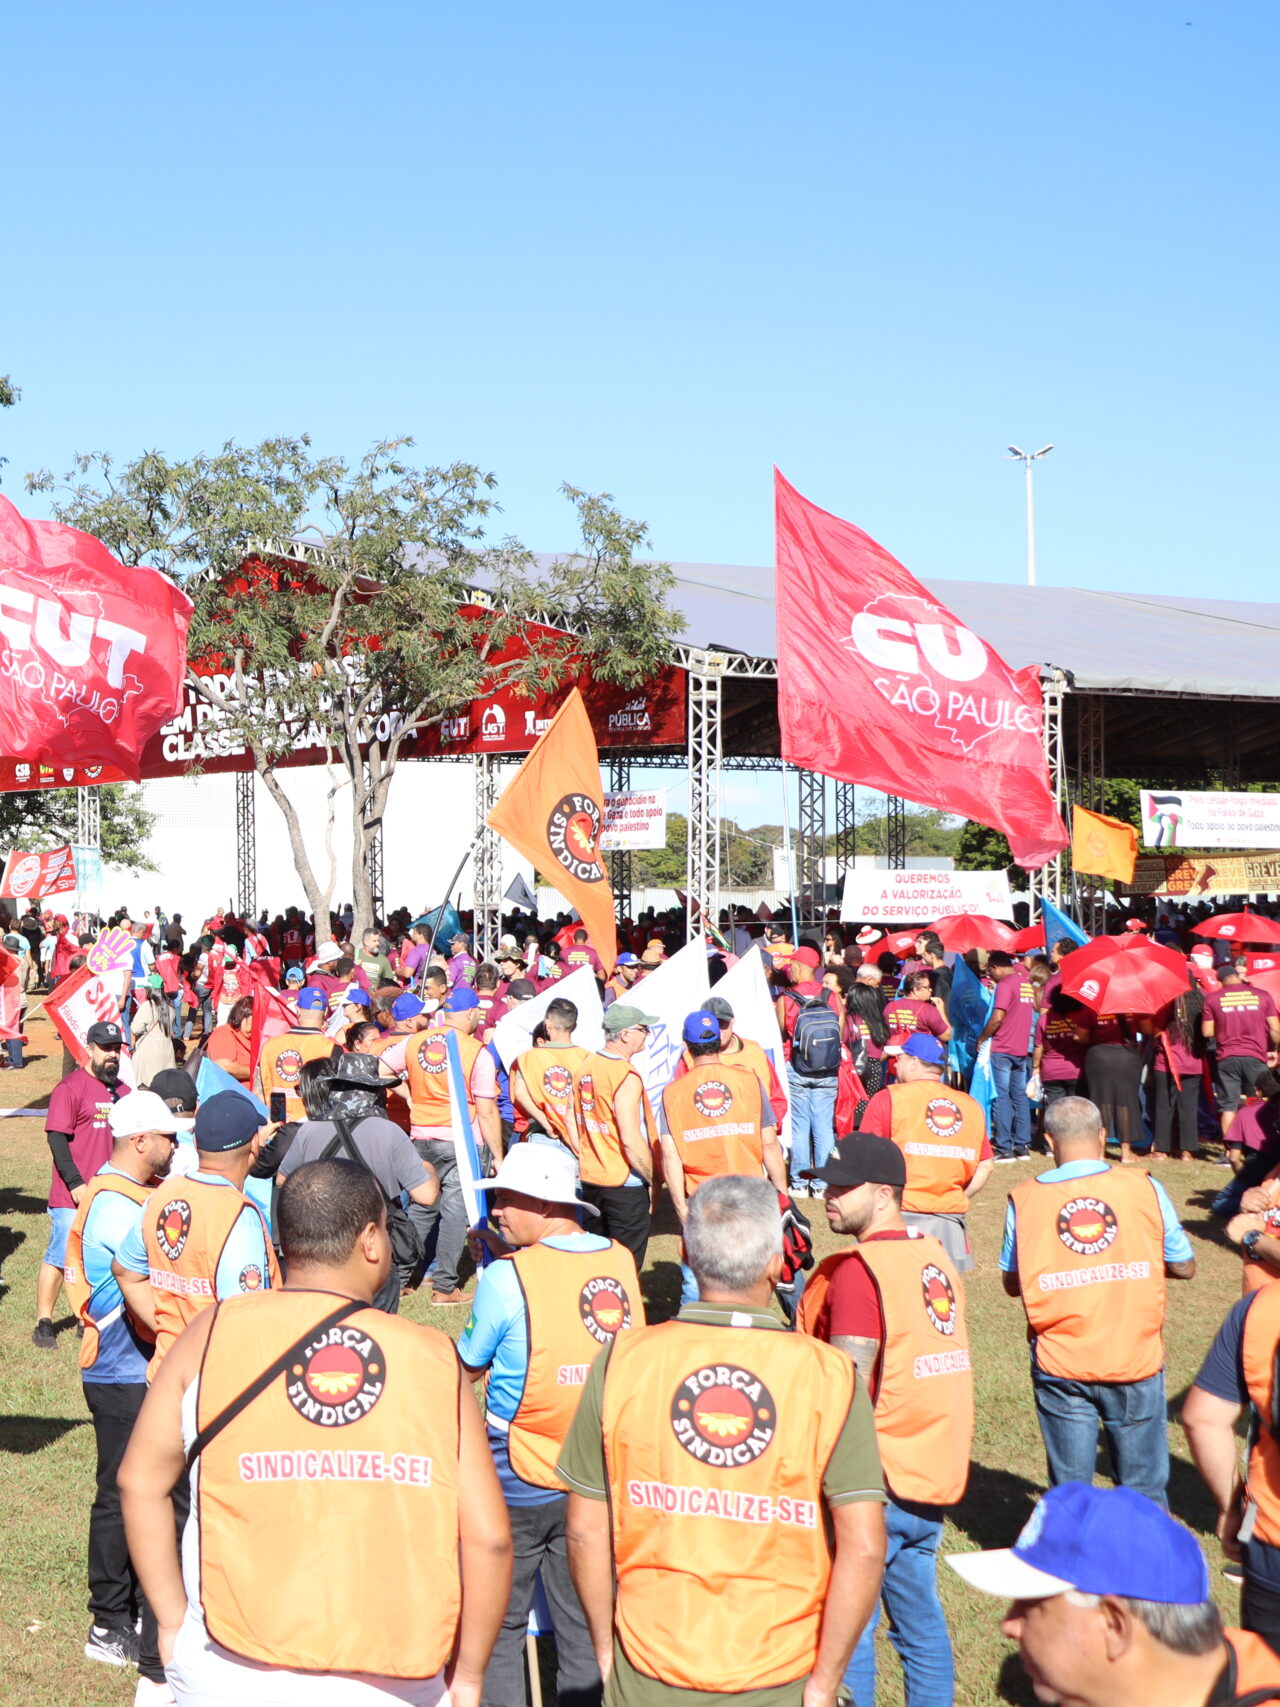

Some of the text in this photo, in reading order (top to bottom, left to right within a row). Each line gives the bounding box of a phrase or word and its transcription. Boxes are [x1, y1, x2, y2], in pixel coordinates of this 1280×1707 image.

[851, 612, 988, 682] CU
[1, 650, 119, 725] SÃO PAULO
[482, 722, 505, 734] UGT
[609, 711, 652, 727] PÚBLICA
[616, 794, 647, 808] genocídio
[648, 795, 656, 804] na
[607, 810, 623, 819] Gaza
[629, 807, 644, 818] todo
[645, 805, 663, 820] apoio
[1247, 808, 1265, 818] Gaza
[619, 820, 650, 834] palestino
[550, 813, 603, 879] SINDICA
[895, 873, 950, 884] QUEREMOS
[880, 887, 962, 900] A VALORIZAÇÃO
[862, 906, 879, 916] DO
[882, 906, 928, 916] SERVIÇO
[426, 1034, 447, 1045] FOR
[417, 1053, 449, 1073] SINDICA
[696, 1081, 726, 1095] FORÇA
[695, 1098, 732, 1117] SINDICAL
[164, 1199, 190, 1221] FORÇA
[1060, 1198, 1105, 1219] FORÇA
[1060, 1225, 1117, 1255] SINDICAL
[1039, 1261, 1150, 1290] SINDICALIZE-SE!
[583, 1278, 623, 1300] FORÇA
[558, 1364, 590, 1386] SIN
[685, 1366, 763, 1402] FORÇA
[288, 1381, 382, 1426] SINDICAL
[673, 1417, 773, 1466] SINDICAL
[239, 1449, 432, 1487] SINDICALIZE-SE!
[628, 1479, 817, 1529] SINDICALIZE-SE!
